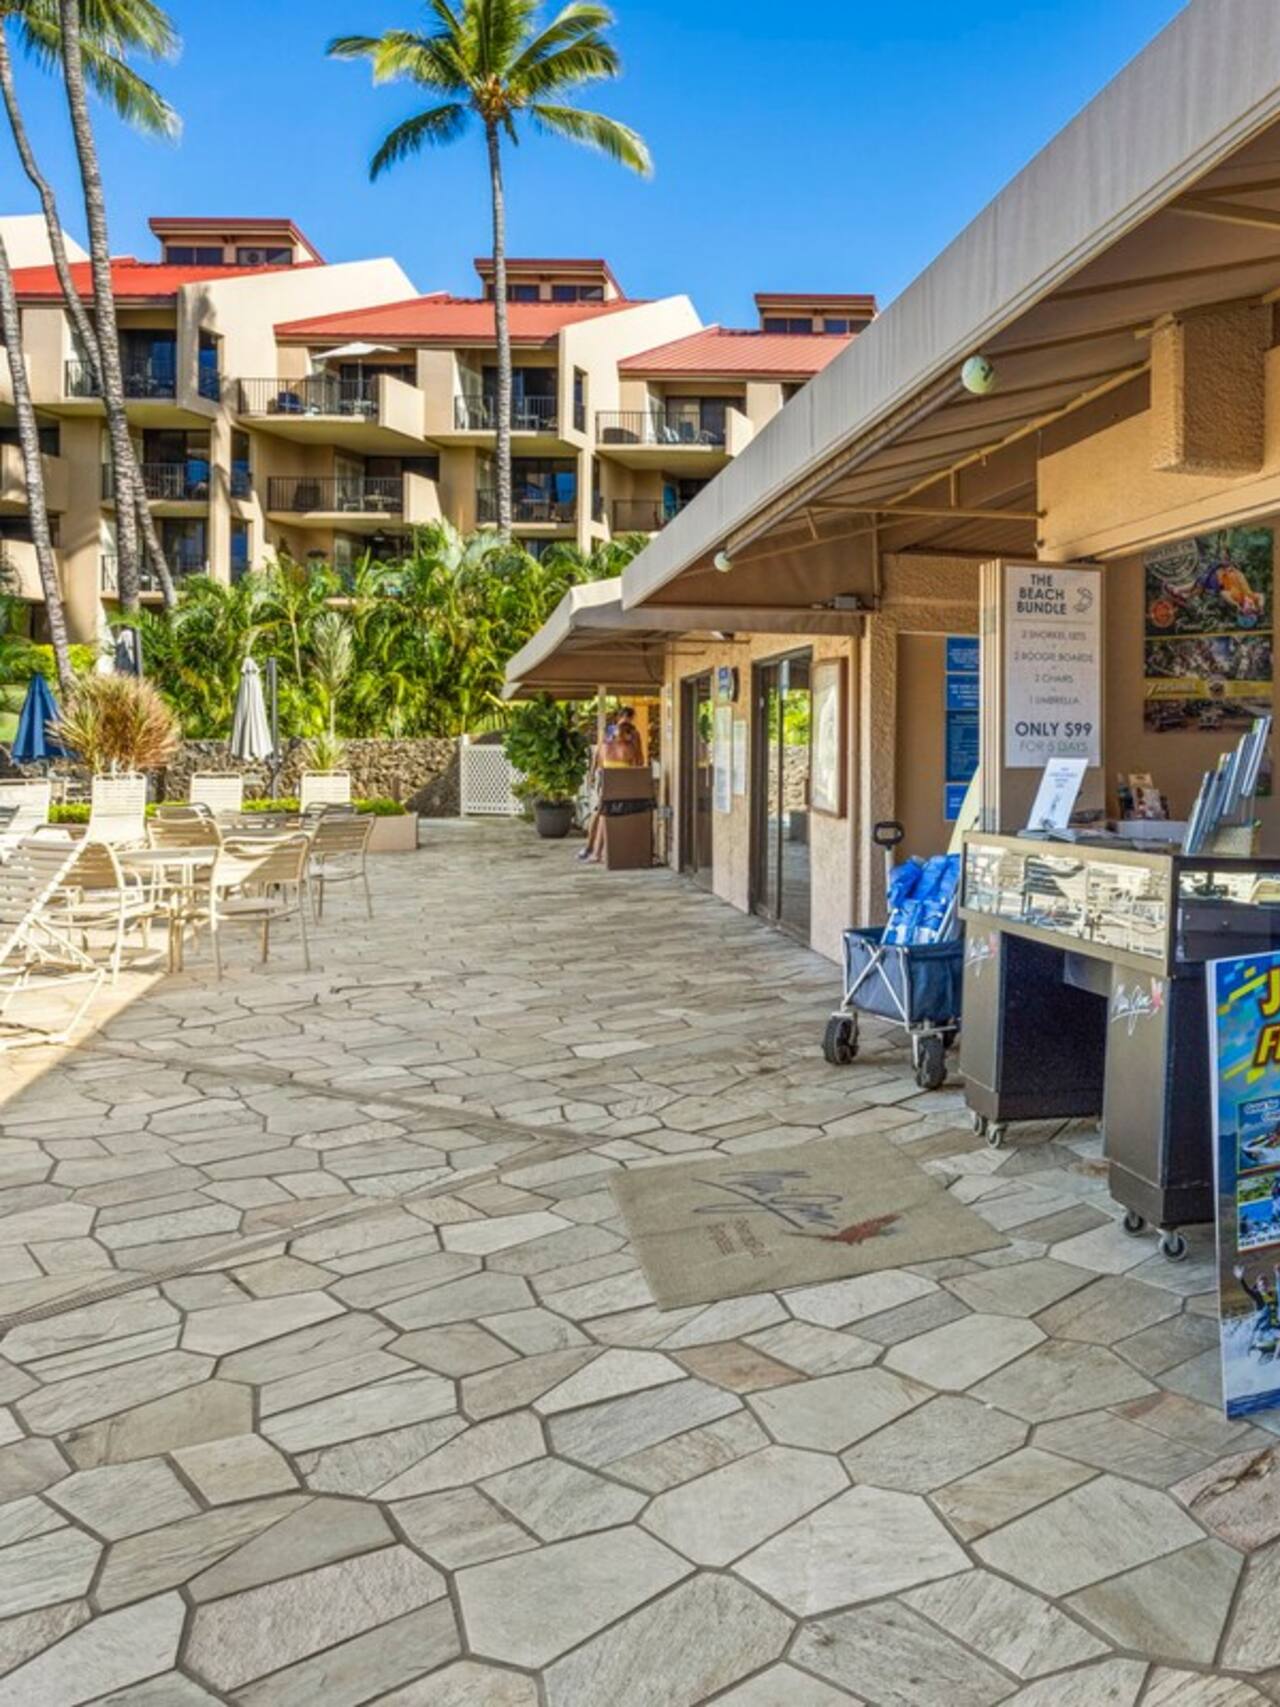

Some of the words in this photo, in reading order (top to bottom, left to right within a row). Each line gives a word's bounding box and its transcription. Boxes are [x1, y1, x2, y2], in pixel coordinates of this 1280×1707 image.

[1030, 573, 1053, 588] THE
[1018, 586, 1066, 602] BEACH
[1016, 600, 1068, 616] BUNDLE
[1020, 652, 1056, 663] BOOGIE
[1057, 652, 1093, 663] BOARDS
[1015, 721, 1059, 737] ONLY
[1064, 721, 1093, 738] $99
[1019, 740, 1045, 752] FOR
[1057, 740, 1088, 752] DAYS
